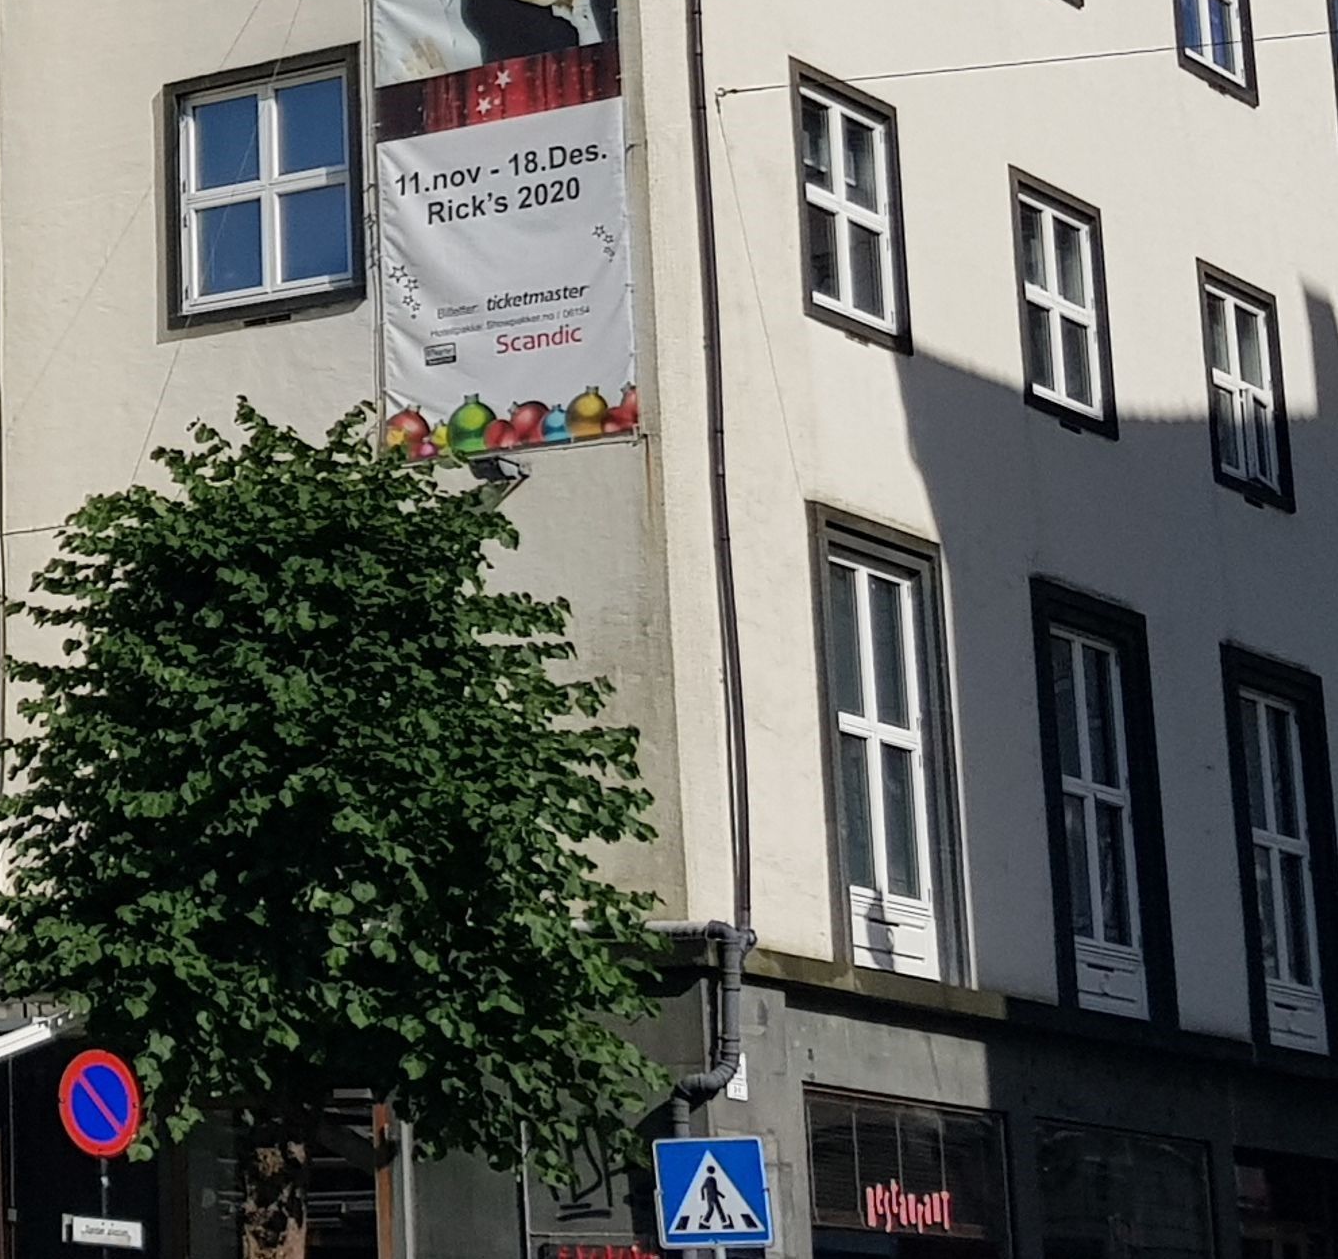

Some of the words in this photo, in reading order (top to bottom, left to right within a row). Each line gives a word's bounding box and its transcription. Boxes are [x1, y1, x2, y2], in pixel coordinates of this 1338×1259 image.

[395, 166, 481, 196] 11.nov
[508, 143, 608, 177] 18.Des.
[427, 192, 509, 225] Rick's
[518, 177, 581, 210] 2020
[486, 285, 590, 312] ticketmaster
[495, 324, 583, 355] Scandic
